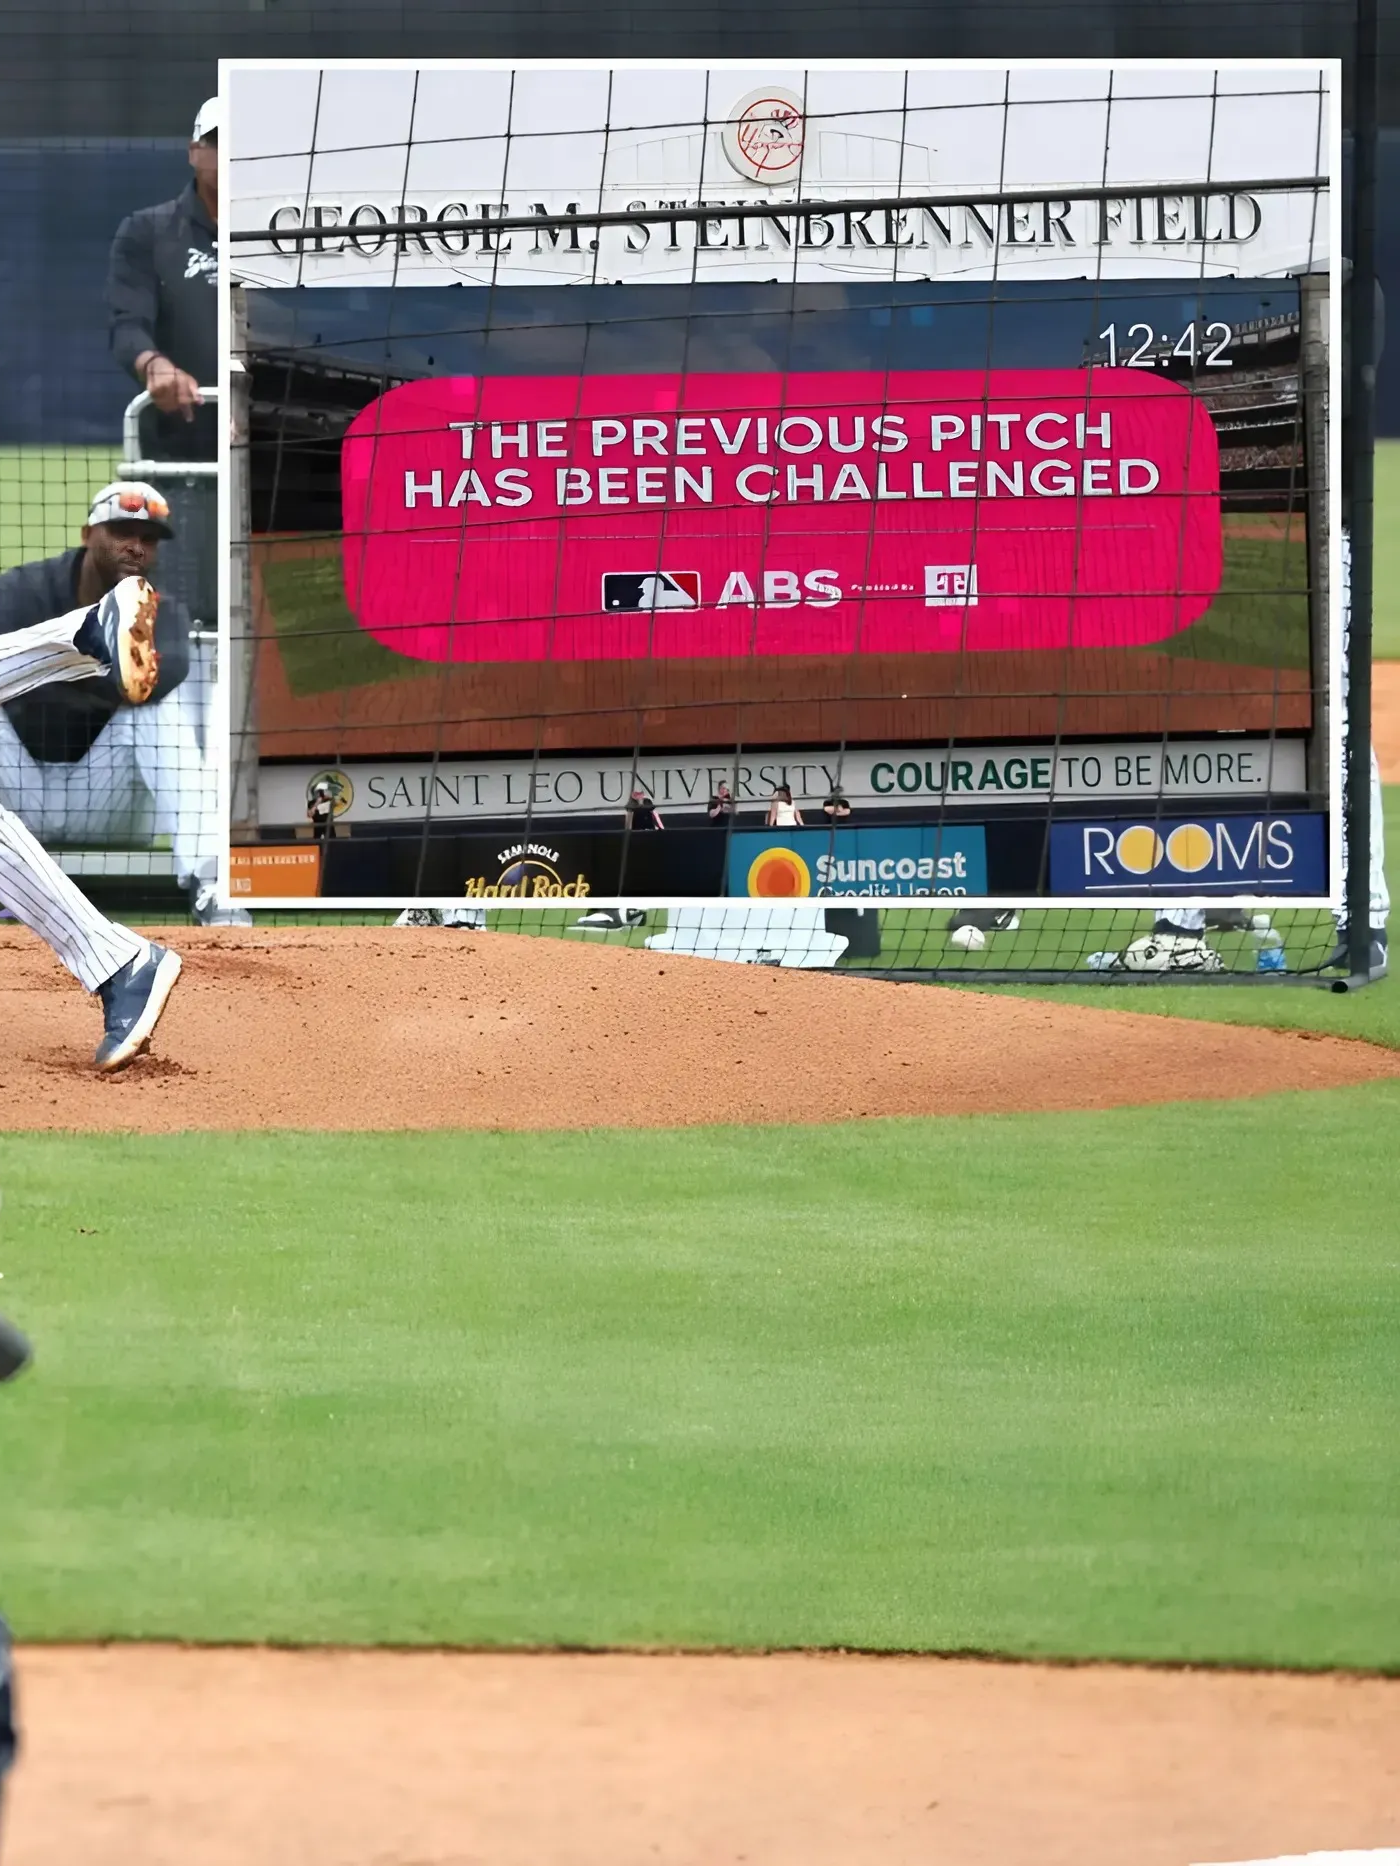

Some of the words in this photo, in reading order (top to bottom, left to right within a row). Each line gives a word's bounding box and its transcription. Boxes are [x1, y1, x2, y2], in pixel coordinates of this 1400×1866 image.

[269, 203, 512, 257] GEORGE
[528, 201, 599, 254] M.
[624, 196, 1077, 254] STEINBRENNER
[1094, 192, 1262, 248] FIELD
[1100, 322, 1233, 367] 12:42
[449, 420, 568, 460] THE
[592, 414, 909, 457] PREVIOUS
[930, 412, 1112, 452] PITCH
[405, 468, 534, 509] HAS
[556, 466, 713, 506] BEEN
[736, 457, 1160, 502] CHALLENGED
[715, 569, 843, 610] ABS
[367, 774, 490, 809] SAINT
[502, 770, 583, 805] LEO
[598, 764, 841, 804] UNIVERSITY
[870, 758, 1051, 793] COURAGE
[1059, 755, 1101, 788] TO
[1115, 755, 1152, 787] BE
[1163, 752, 1262, 785] MORE.
[816, 851, 967, 883] Suncoast
[1084, 820, 1294, 876] ROOMS
[532, 873, 590, 898] Rock
